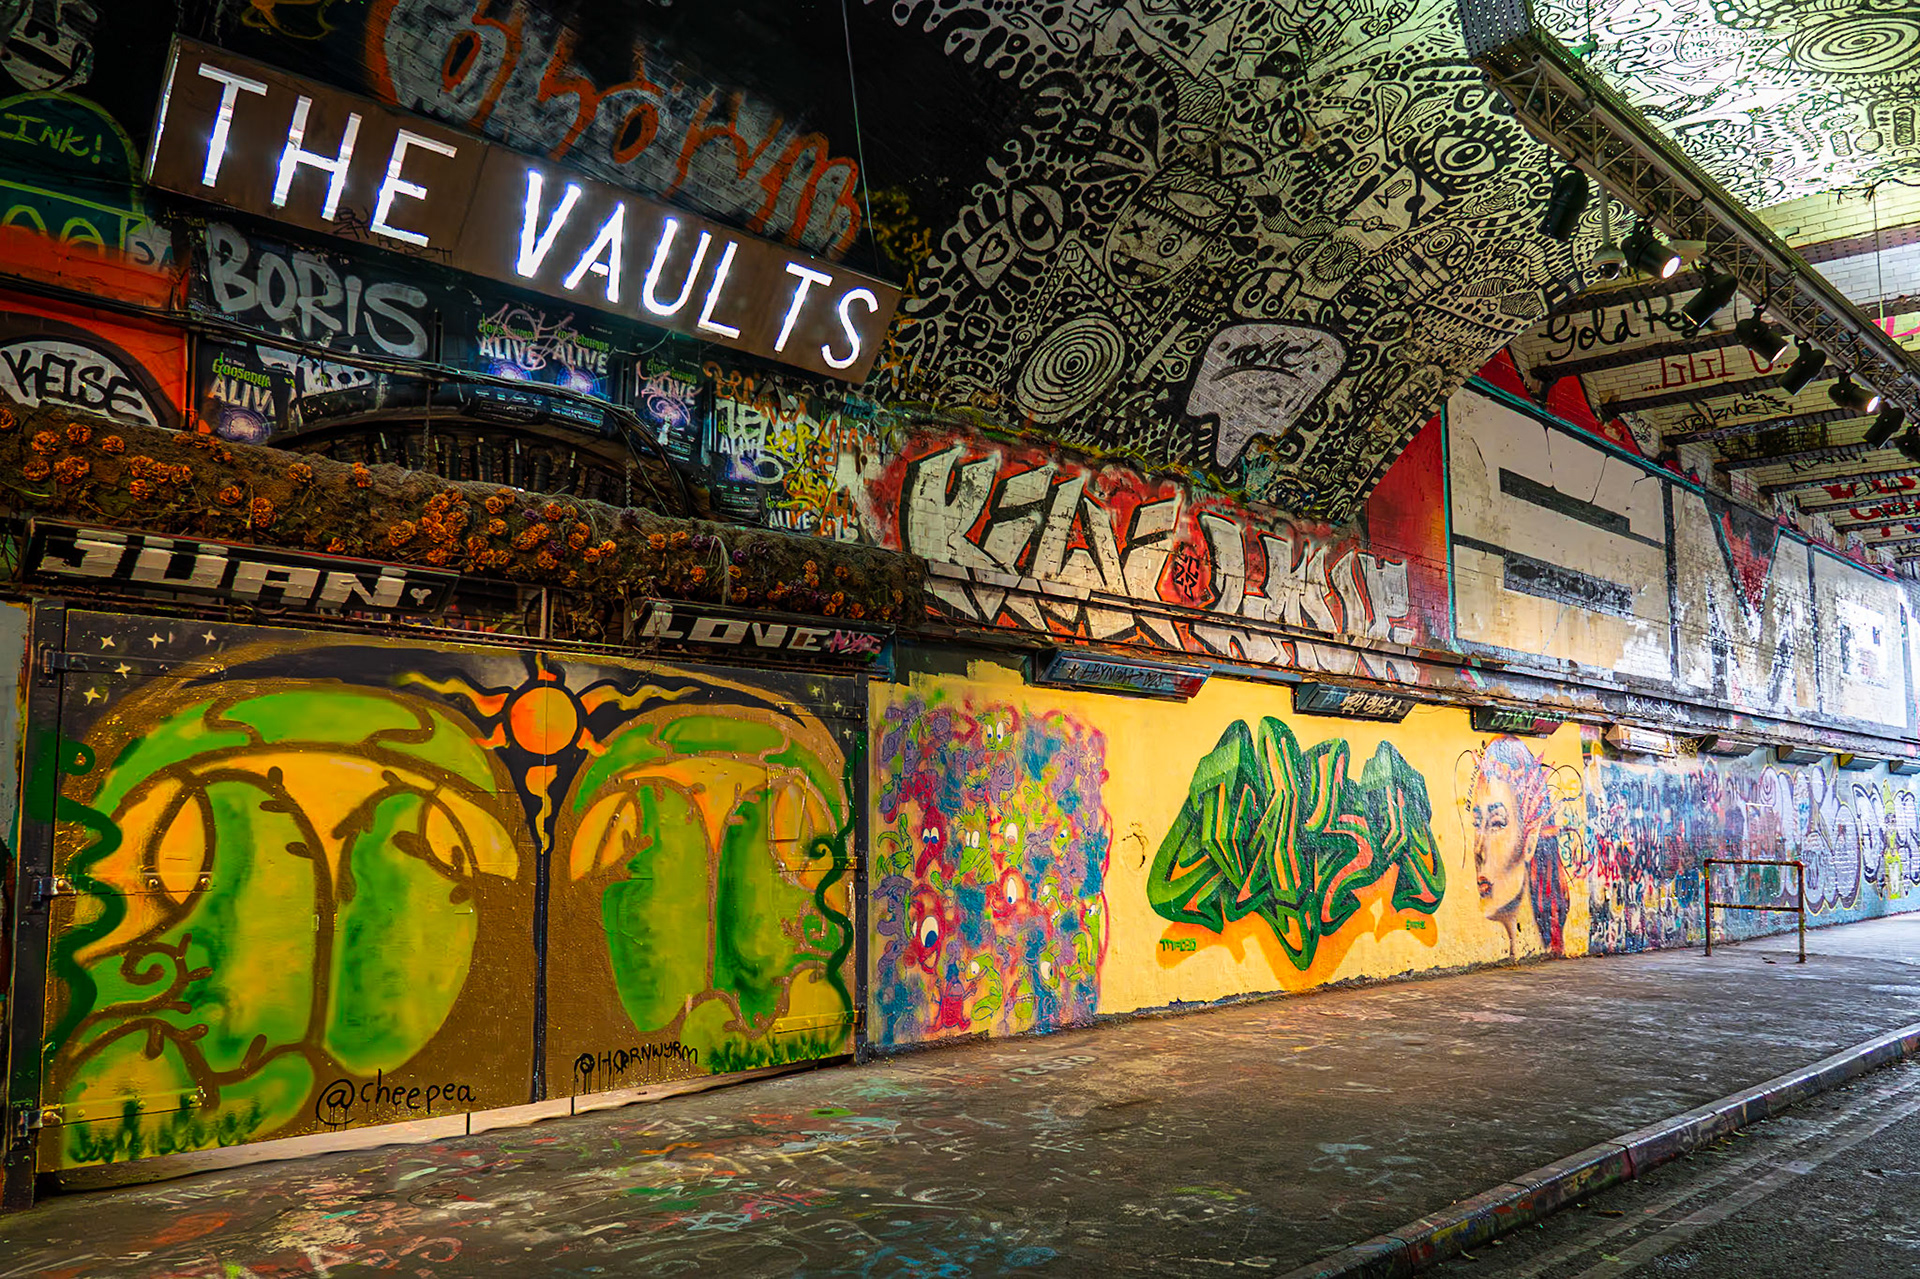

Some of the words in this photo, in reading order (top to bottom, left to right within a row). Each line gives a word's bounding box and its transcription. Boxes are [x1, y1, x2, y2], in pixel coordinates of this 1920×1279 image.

[0, 112, 102, 165] INK!
[197, 62, 458, 248] THE
[515, 168, 879, 370] VAULTS
[205, 222, 428, 358] BORIS
[207, 374, 277, 418] ALIV
[36, 529, 407, 608] JUAN
[640, 602, 831, 652] LOVE
[315, 1068, 477, 1127] @cheepea
